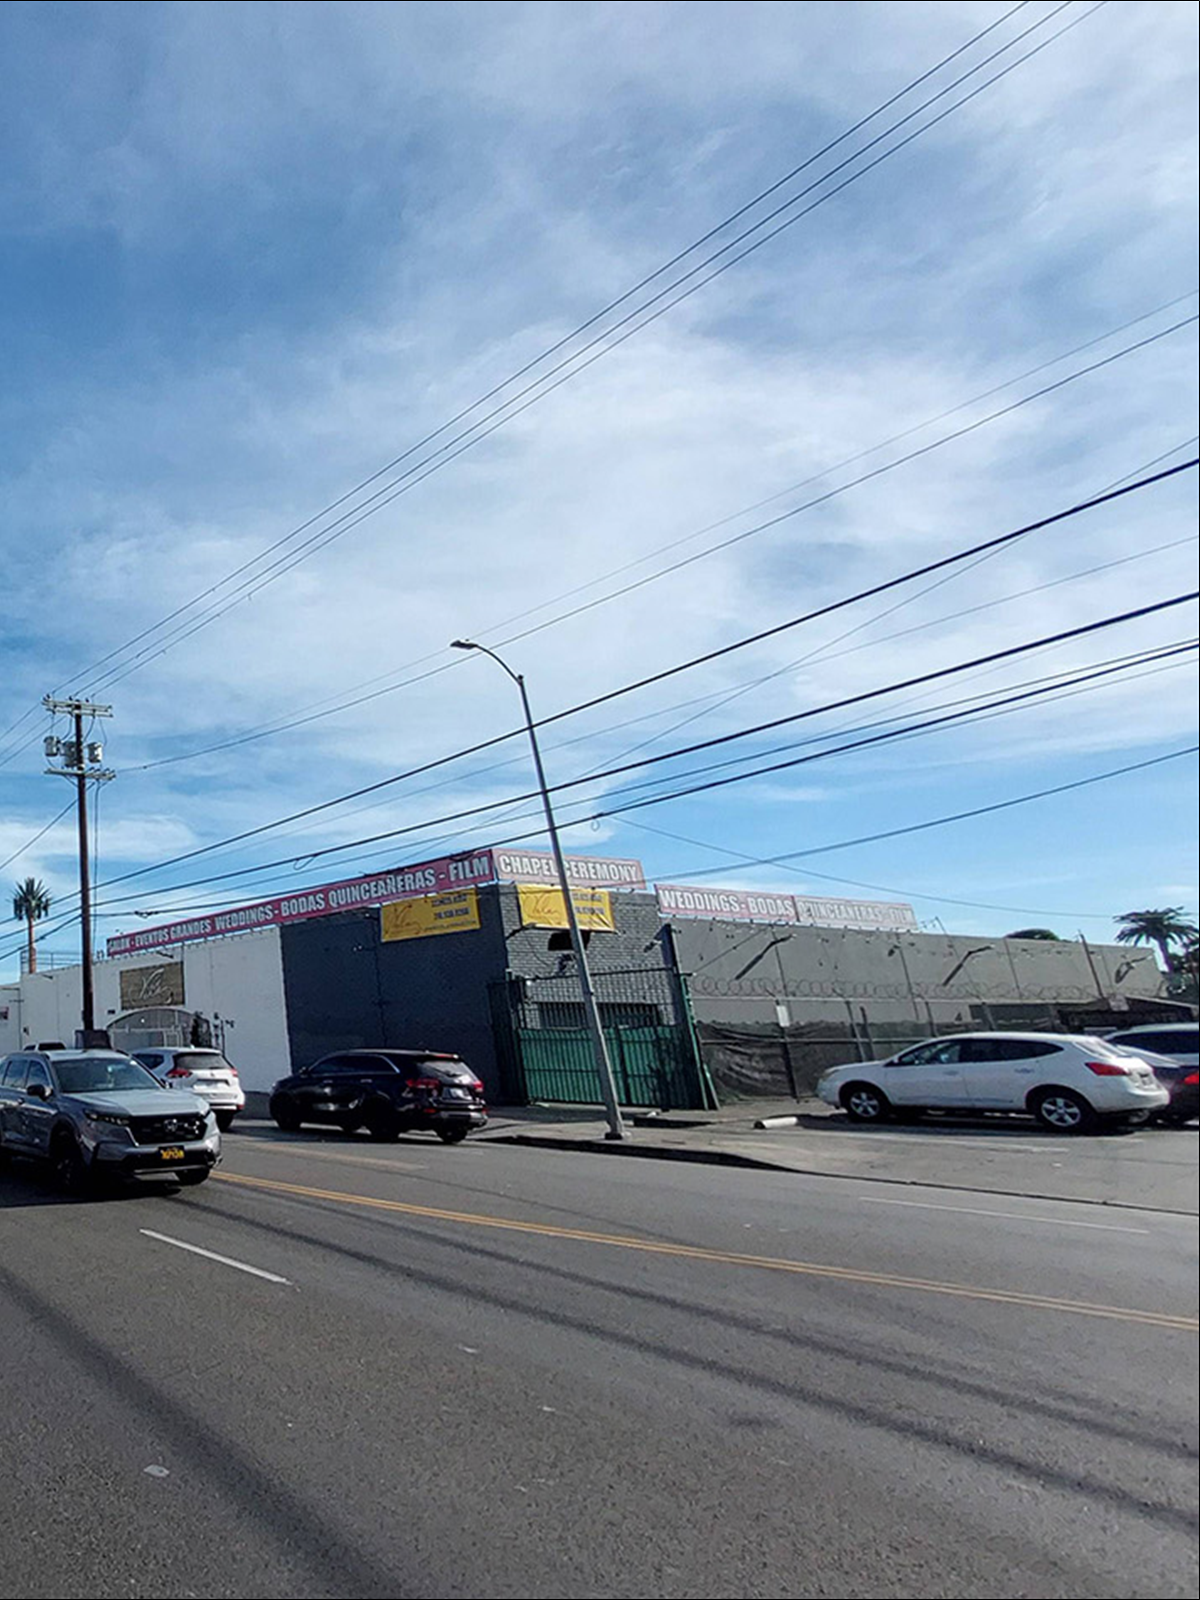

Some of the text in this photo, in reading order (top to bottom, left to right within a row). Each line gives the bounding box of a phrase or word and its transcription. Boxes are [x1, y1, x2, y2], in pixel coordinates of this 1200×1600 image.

[500, 854, 637, 882] CHAPEL CEREMONY
[170, 919, 212, 940] GRANDES
[281, 893, 325, 917] BODAS
[448, 856, 490, 882] FILM
[659, 889, 740, 913] WEDDINGS
[747, 895, 795, 917] BODAS
